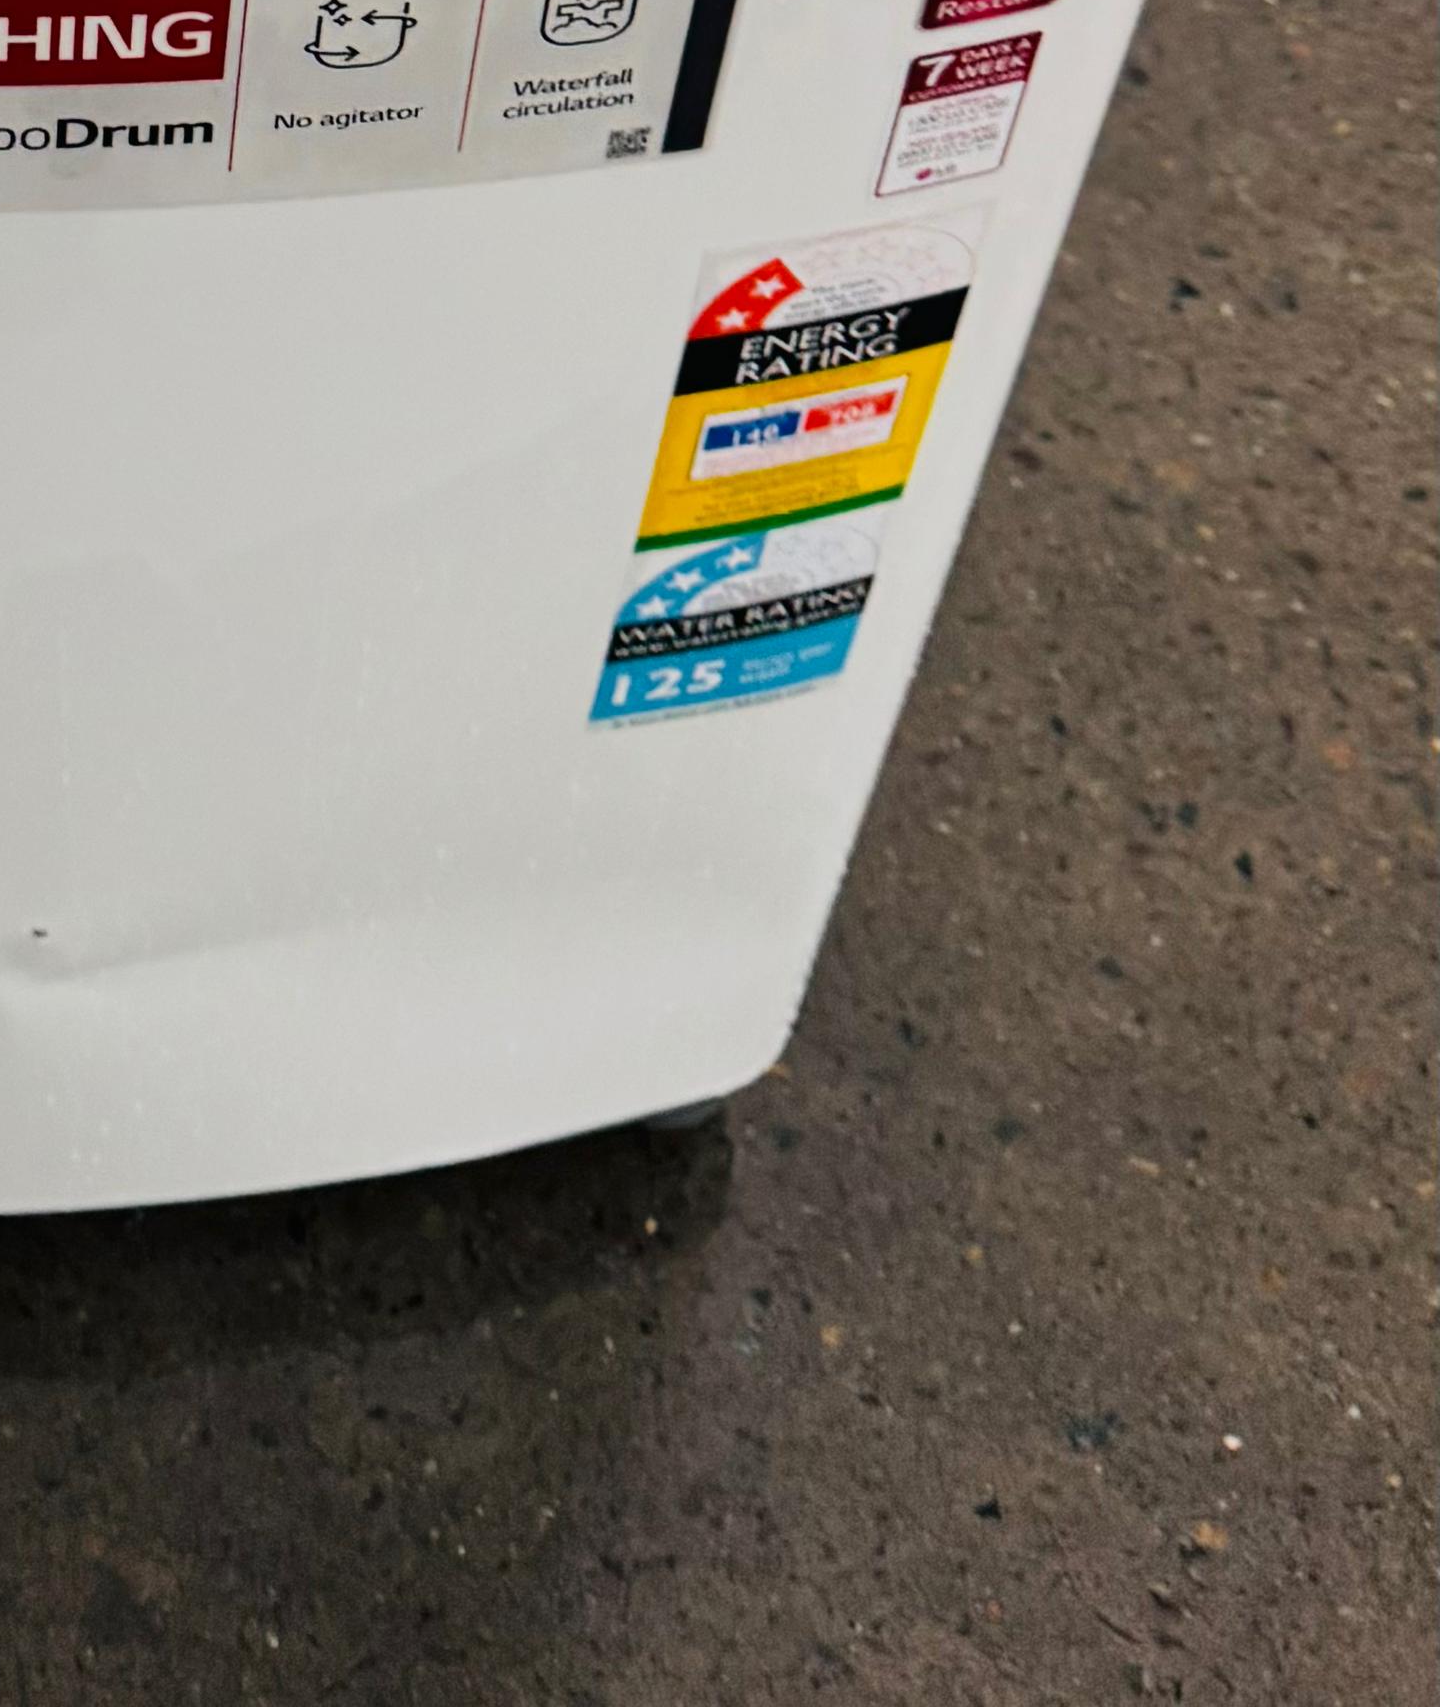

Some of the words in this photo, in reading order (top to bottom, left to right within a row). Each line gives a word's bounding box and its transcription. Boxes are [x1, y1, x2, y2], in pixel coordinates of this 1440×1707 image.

[513, 67, 634, 97] Waterfall
[917, 54, 957, 87] 7
[956, 55, 1026, 80] WEEK
[274, 113, 312, 130] No
[320, 104, 424, 130] agitator
[502, 90, 635, 120] circulation
[740, 306, 912, 361] ENERGY
[735, 332, 900, 385] RATING
[618, 611, 735, 645] WATER
[611, 659, 727, 708] 125
